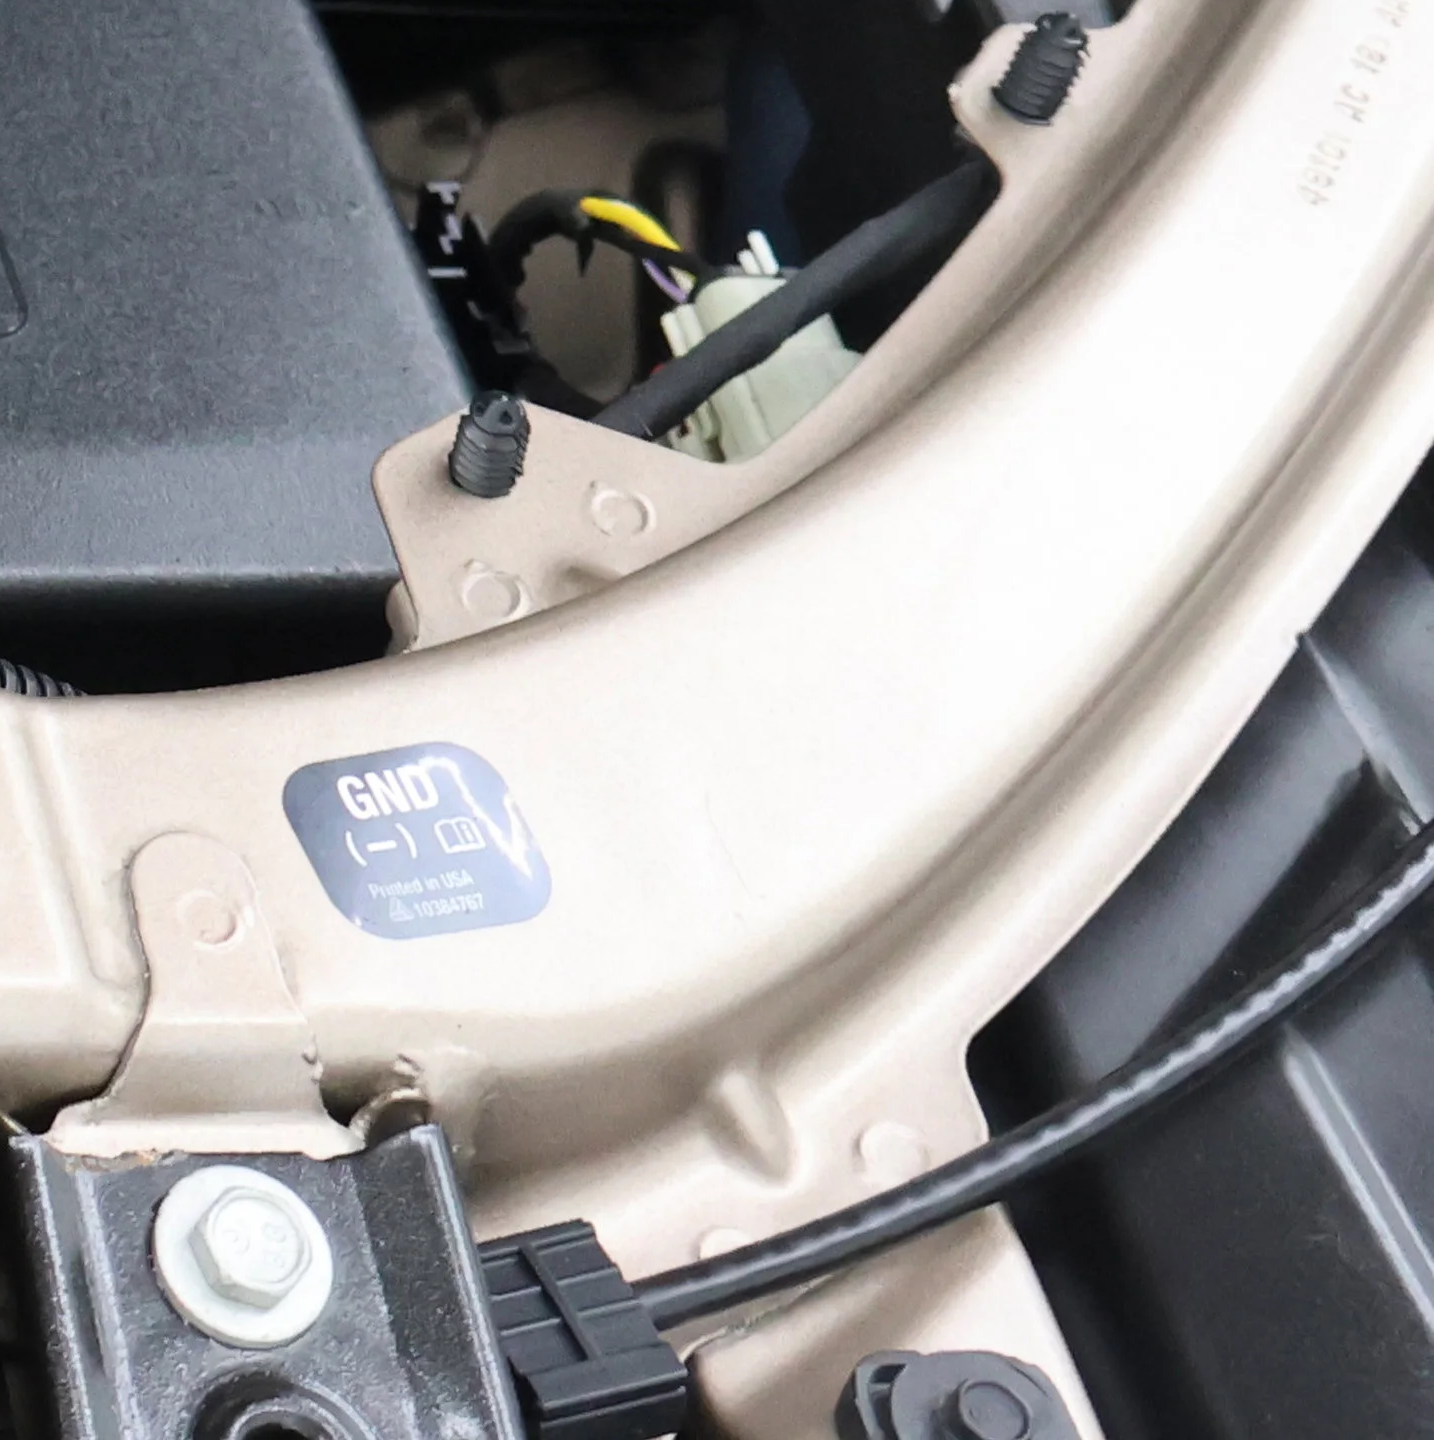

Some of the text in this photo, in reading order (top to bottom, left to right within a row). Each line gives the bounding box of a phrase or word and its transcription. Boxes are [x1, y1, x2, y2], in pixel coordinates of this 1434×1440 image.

[336, 762, 440, 821] GND
[368, 868, 475, 900] Printed in USA
